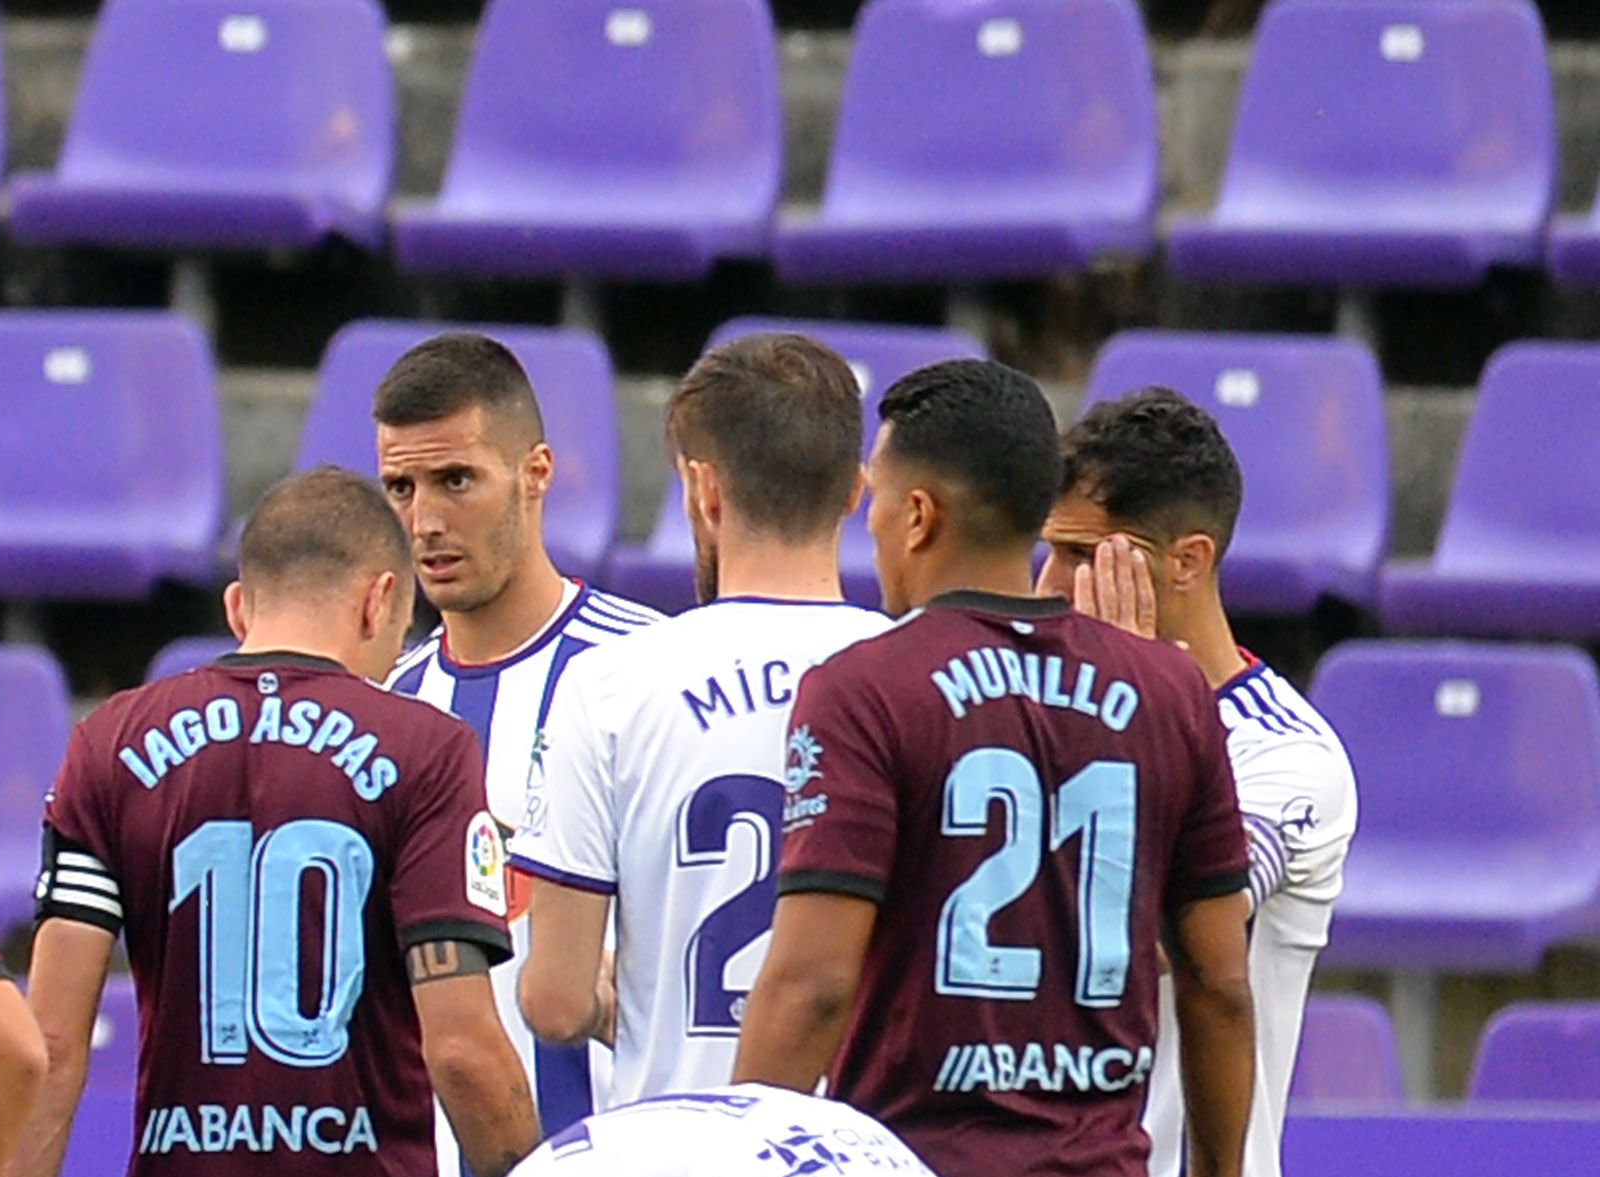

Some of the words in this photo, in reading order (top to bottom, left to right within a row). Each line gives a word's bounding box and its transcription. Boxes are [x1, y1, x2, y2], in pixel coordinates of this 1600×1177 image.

[119, 697, 241, 789] IAGO
[931, 647, 1139, 732] MURILLO
[167, 819, 374, 1067] 10
[936, 747, 1138, 1008] 21
